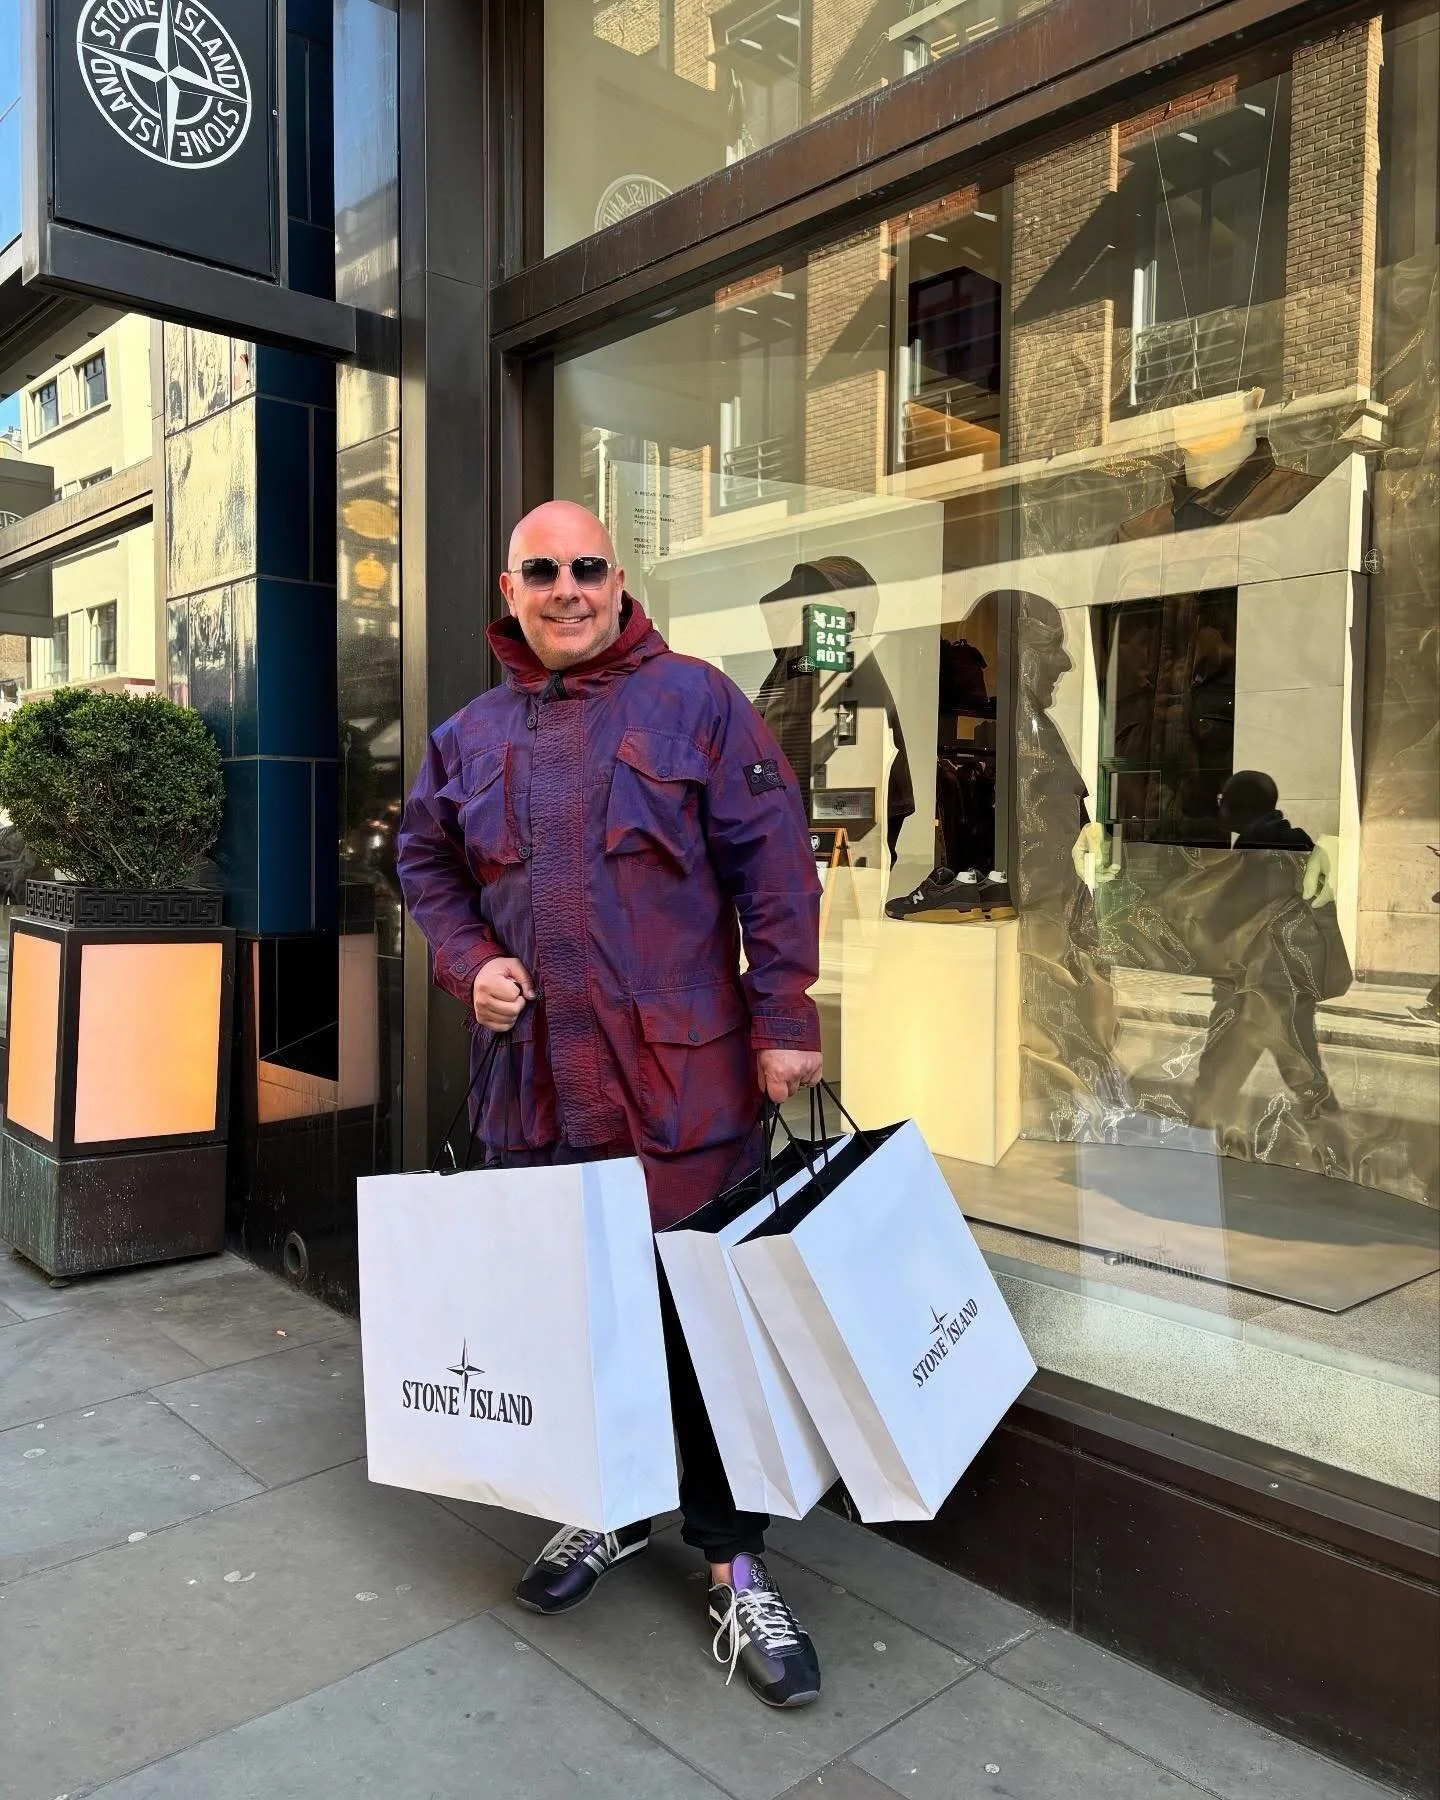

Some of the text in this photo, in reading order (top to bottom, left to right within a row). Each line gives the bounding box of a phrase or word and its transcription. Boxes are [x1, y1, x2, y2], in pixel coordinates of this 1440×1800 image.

[91, 0, 240, 89] STONE ISLAND
[90, 58, 240, 157] STONE ISLAND
[912, 1298, 978, 1388] STONE ISLAND
[402, 1380, 533, 1426] STONE ISLAND
